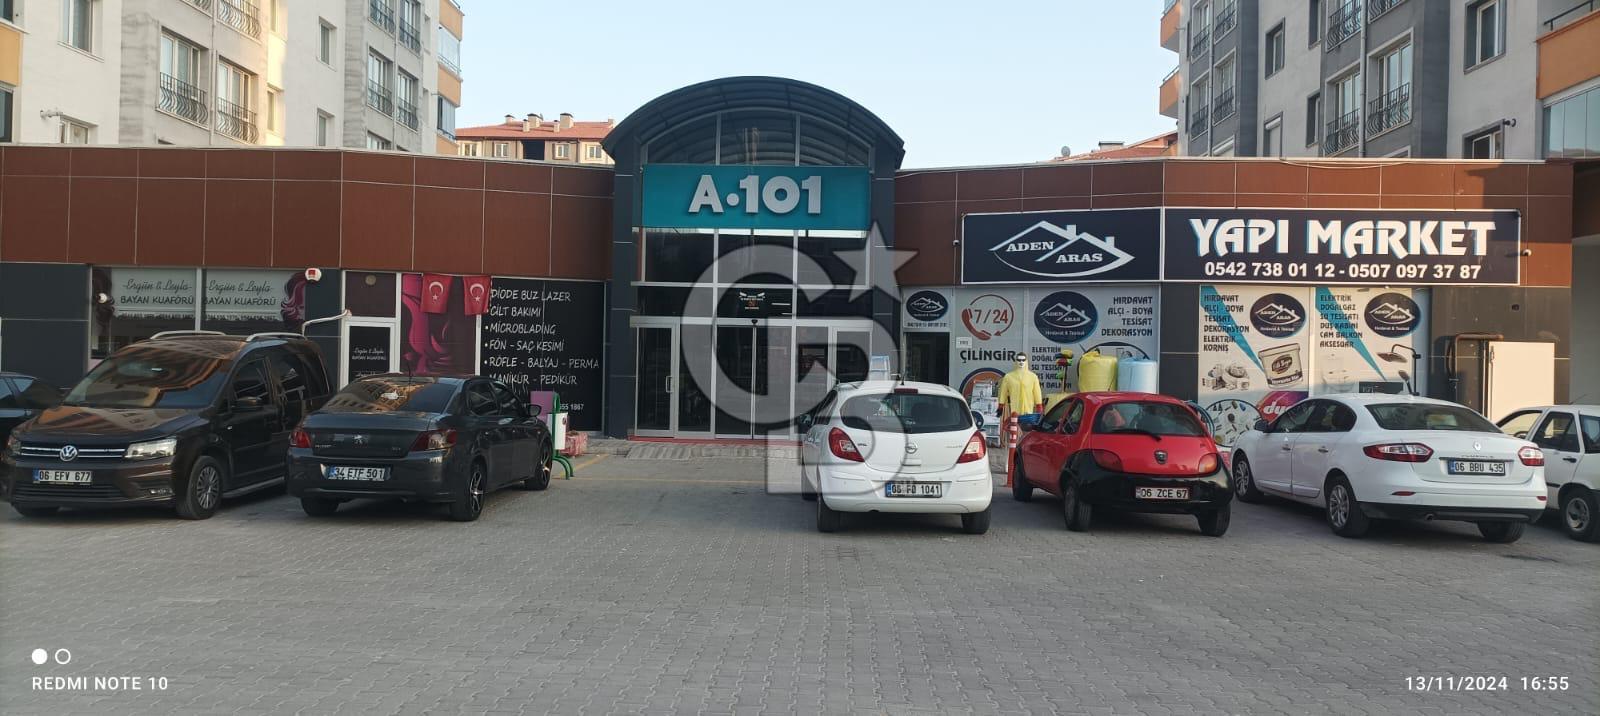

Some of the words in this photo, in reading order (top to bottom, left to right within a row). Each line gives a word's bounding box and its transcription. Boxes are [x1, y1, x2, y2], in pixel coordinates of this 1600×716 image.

[1188, 218, 1289, 257] YAPI
[1306, 219, 1496, 260] MARKET
[1006, 241, 1055, 252] ADEN
[1056, 253, 1103, 263] ARAS
[1204, 261, 1246, 277] 0542
[1251, 262, 1283, 277] 738
[1288, 262, 1307, 278] 01
[1314, 263, 1336, 278] 12
[1348, 263, 1390, 279] 0507
[1395, 263, 1427, 279] 097
[1432, 264, 1453, 279] 37
[1459, 264, 1482, 280] 87
[121, 295, 149, 305] BAYAN
[521, 290, 540, 301] BUZ
[541, 291, 572, 301] LAZER
[1113, 296, 1153, 305] HIRDAVAT
[511, 306, 541, 317] BAKIMI
[1132, 307, 1153, 315] BOYA
[974, 309, 1008, 324] 7/24
[1101, 328, 1153, 337] DEKORASYON
[1203, 325, 1249, 333] DEKORASYON
[527, 357, 559, 369] BALYAJ
[569, 358, 600, 369] PERMA
[1454, 463, 1465, 472] 06
[1469, 463, 1484, 472] BBU
[1489, 464, 1504, 473] 435
[40, 471, 50, 480] 06
[55, 471, 71, 481] EFV
[75, 472, 91, 481] 677
[921, 486, 940, 494] 1041
[1141, 488, 1152, 497] 06
[1157, 489, 1173, 498] ZCE
